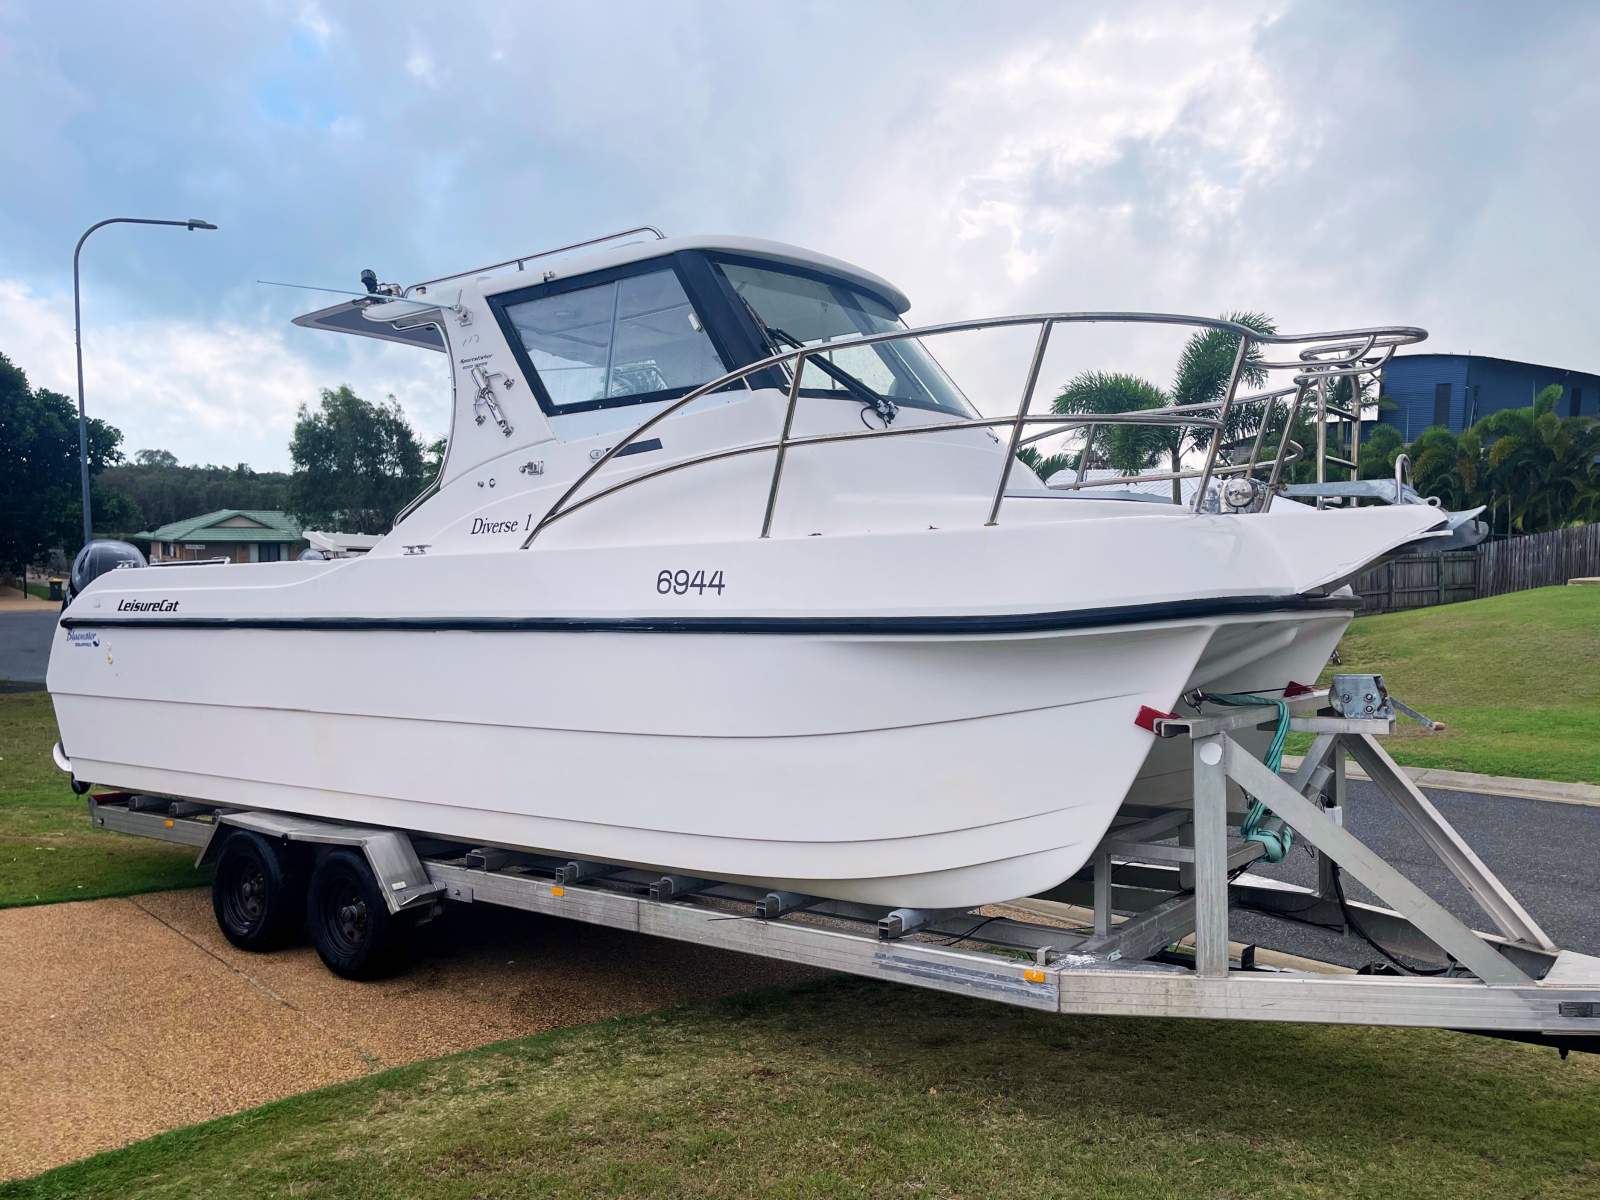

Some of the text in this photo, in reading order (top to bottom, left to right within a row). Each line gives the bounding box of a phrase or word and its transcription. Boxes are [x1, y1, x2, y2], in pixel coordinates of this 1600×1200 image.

[470, 517, 519, 535] Diverse
[656, 569, 726, 596] 6944
[117, 599, 180, 612] LeisureCat
